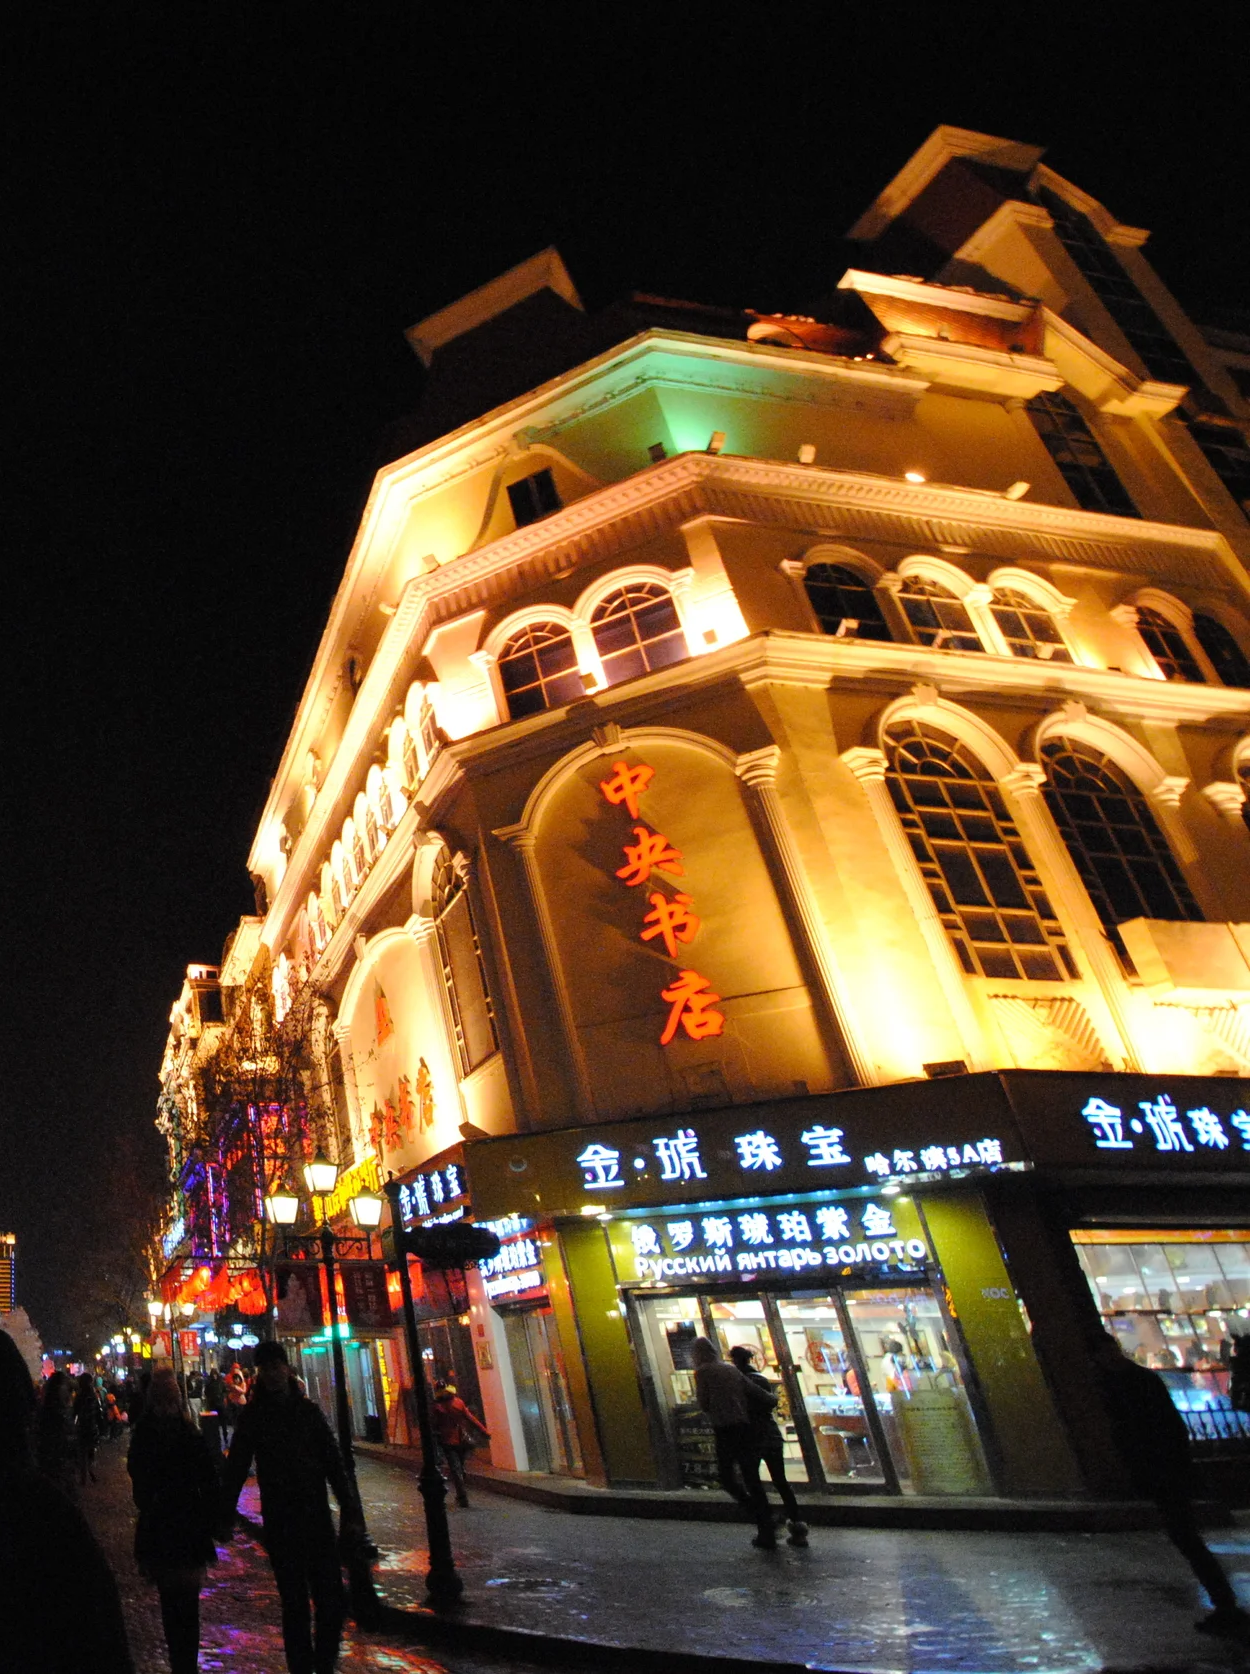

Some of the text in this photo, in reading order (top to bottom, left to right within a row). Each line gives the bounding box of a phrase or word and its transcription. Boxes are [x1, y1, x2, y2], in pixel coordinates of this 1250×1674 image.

[600, 761, 726, 1045] 中央书店
[631, 1203, 896, 1255] 俄罗斯琥珀紫金
[633, 1248, 732, 1280] Русский
[736, 1246, 822, 1271] янтарь
